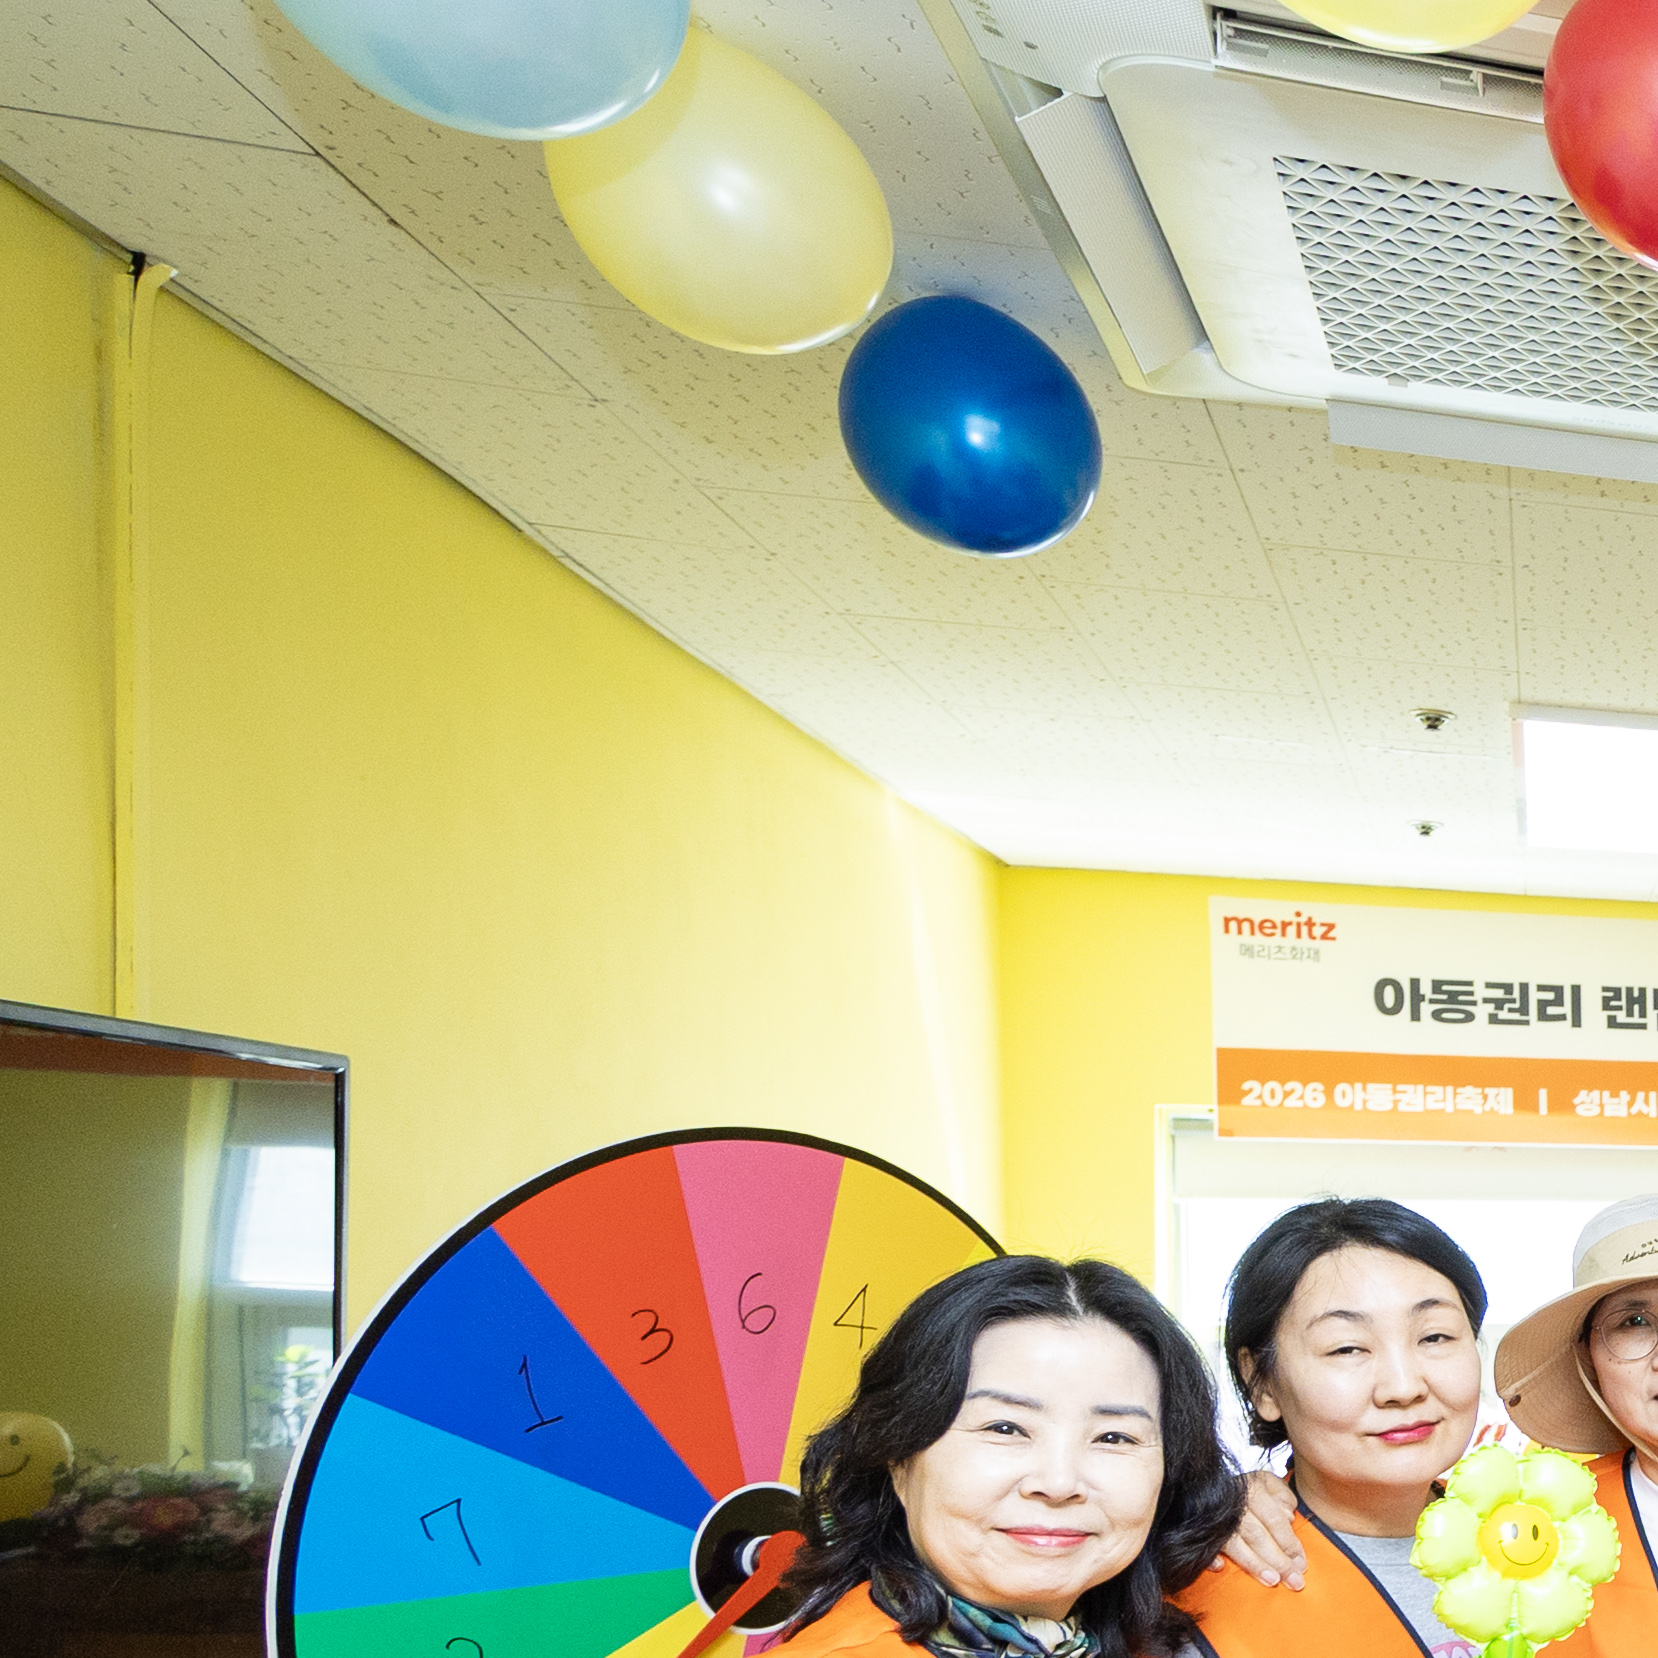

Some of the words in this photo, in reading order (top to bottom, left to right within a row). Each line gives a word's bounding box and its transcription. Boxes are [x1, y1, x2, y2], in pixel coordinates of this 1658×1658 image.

[1223, 911, 1337, 941] meritz
[1239, 943, 1321, 963] 메리츠화재
[1373, 977, 1582, 1028] 아동권리
[1241, 1080, 1326, 1108] 2026
[1333, 1082, 1514, 1115] 아동권리축제
[736, 1272, 776, 1335] 6
[833, 1283, 877, 1349] 4
[630, 1308, 673, 1365] 3
[518, 1355, 563, 1434] 1
[420, 1497, 481, 1566] 7
